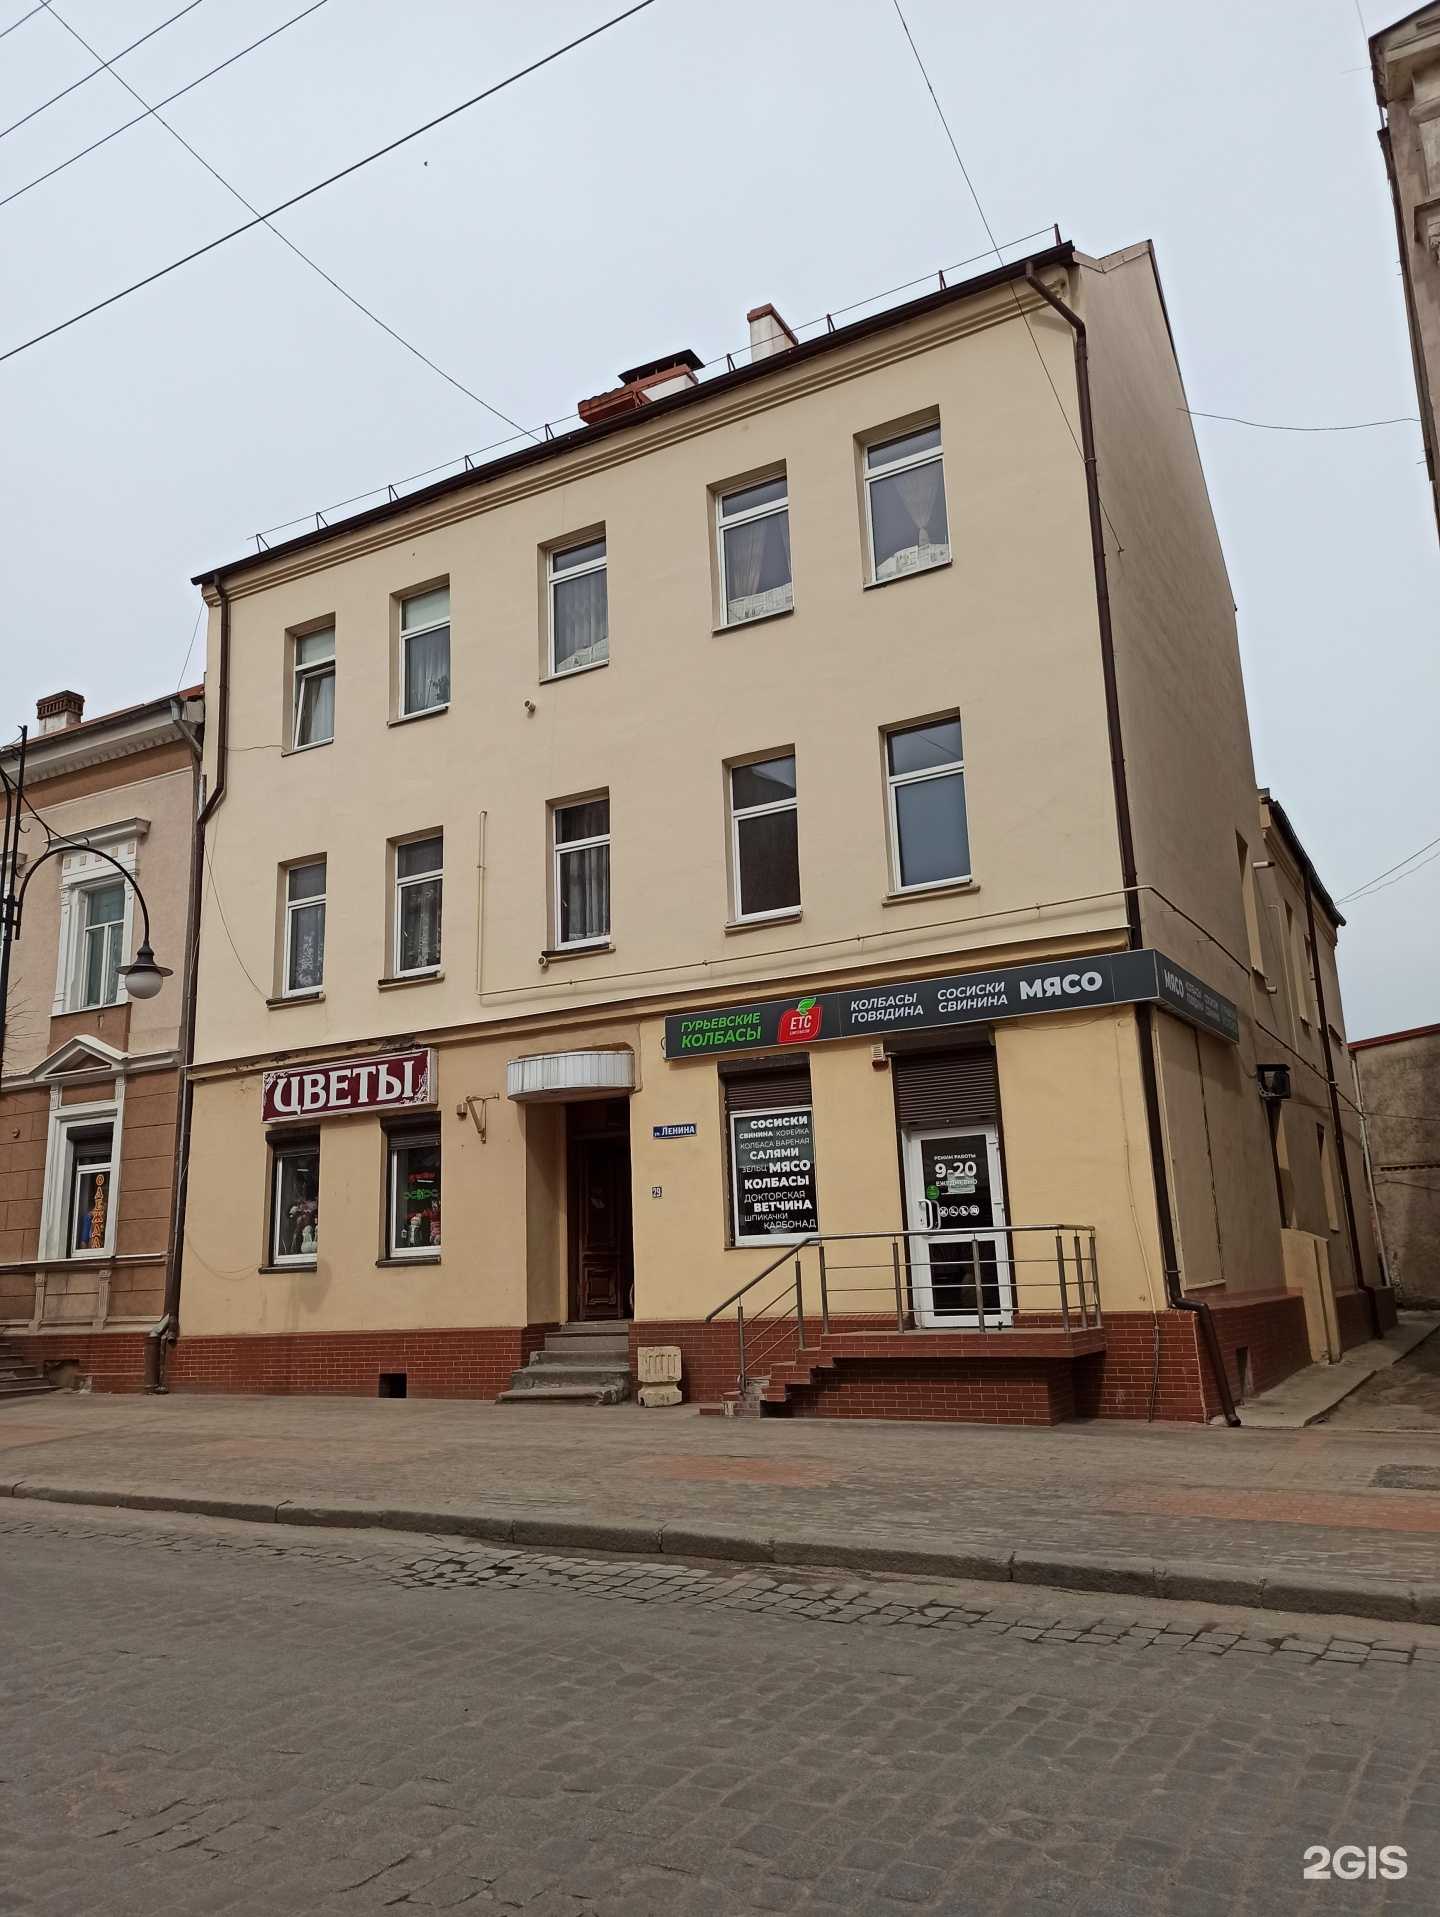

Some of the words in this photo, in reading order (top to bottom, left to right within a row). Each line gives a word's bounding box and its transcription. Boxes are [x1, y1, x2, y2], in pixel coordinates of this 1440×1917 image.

[937, 981, 1005, 1000] СОСИСКИ
[1019, 971, 1103, 1000] МЯСО
[850, 992, 917, 1011] КОЛБАСЫ
[938, 994, 1008, 1013] СВИНИНА
[851, 1004, 924, 1024] ГОВЯДИНА
[681, 1012, 761, 1033] ГУРЬЕВСКИЕ
[681, 1026, 762, 1049] КОЛБАСЫ
[273, 1060, 415, 1116] ЦВЕТЫ
[750, 1115, 808, 1129] СОСИСКИ
[661, 1125, 695, 1136] ЛЕНИНА
[739, 1131, 773, 1140] СВИНИНА
[776, 1127, 809, 1137] КОРЕЙКА
[740, 1140, 775, 1150] КОЛБАСА
[775, 1137, 810, 1147] ВАРЕНАЯ
[749, 1147, 799, 1160] САЛЯМИ
[768, 1159, 811, 1174] МЯСО
[935, 1161, 977, 1178] 9-20
[744, 1175, 810, 1190] КОЛБАСЫ
[744, 1190, 806, 1204] ДОКТОРСКАЯ
[753, 1199, 813, 1213] ВЕТЧИНА
[744, 1212, 788, 1222] ШПИКАЧКИ
[763, 1218, 817, 1230] КАРБОНАД
